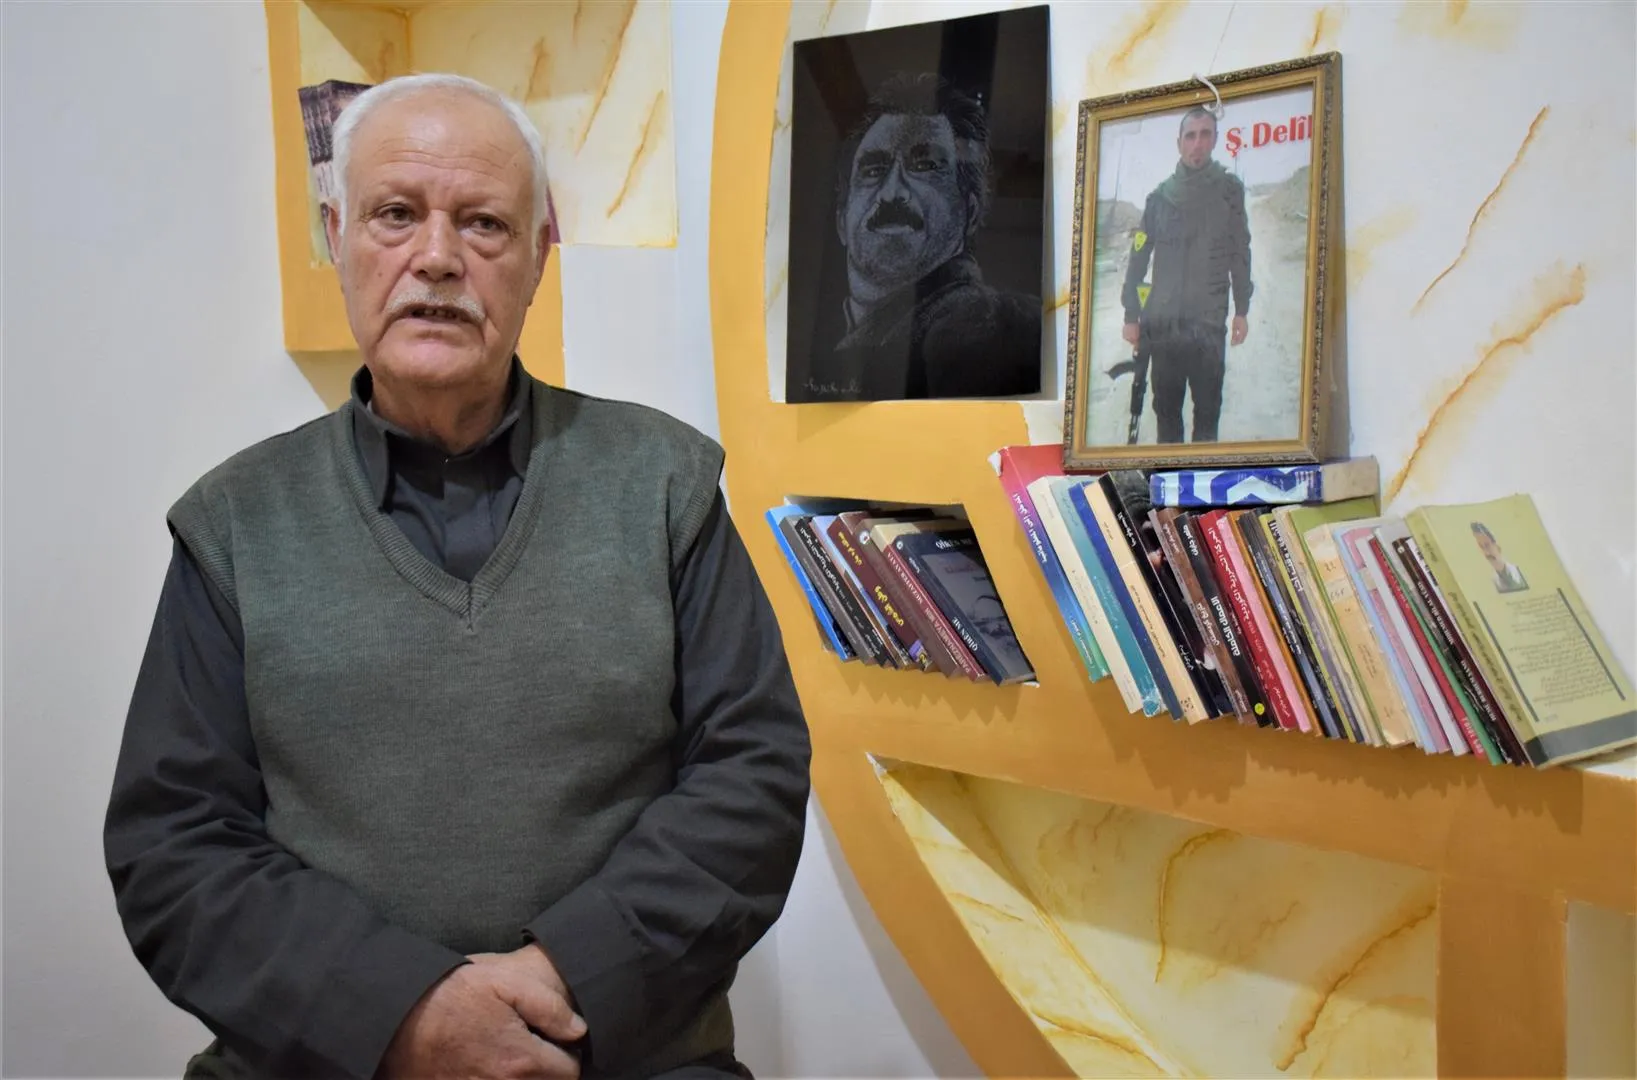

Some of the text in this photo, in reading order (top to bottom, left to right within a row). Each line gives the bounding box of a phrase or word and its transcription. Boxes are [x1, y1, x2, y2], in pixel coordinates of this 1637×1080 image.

[1205, 525, 1224, 556] الحركة
[1216, 552, 1239, 588] التحررية
[1230, 587, 1251, 621] الكوردية
[950, 615, 964, 630] ME
[1209, 594, 1230, 629] الاعمال
[1221, 624, 1241, 658] الكاملة
